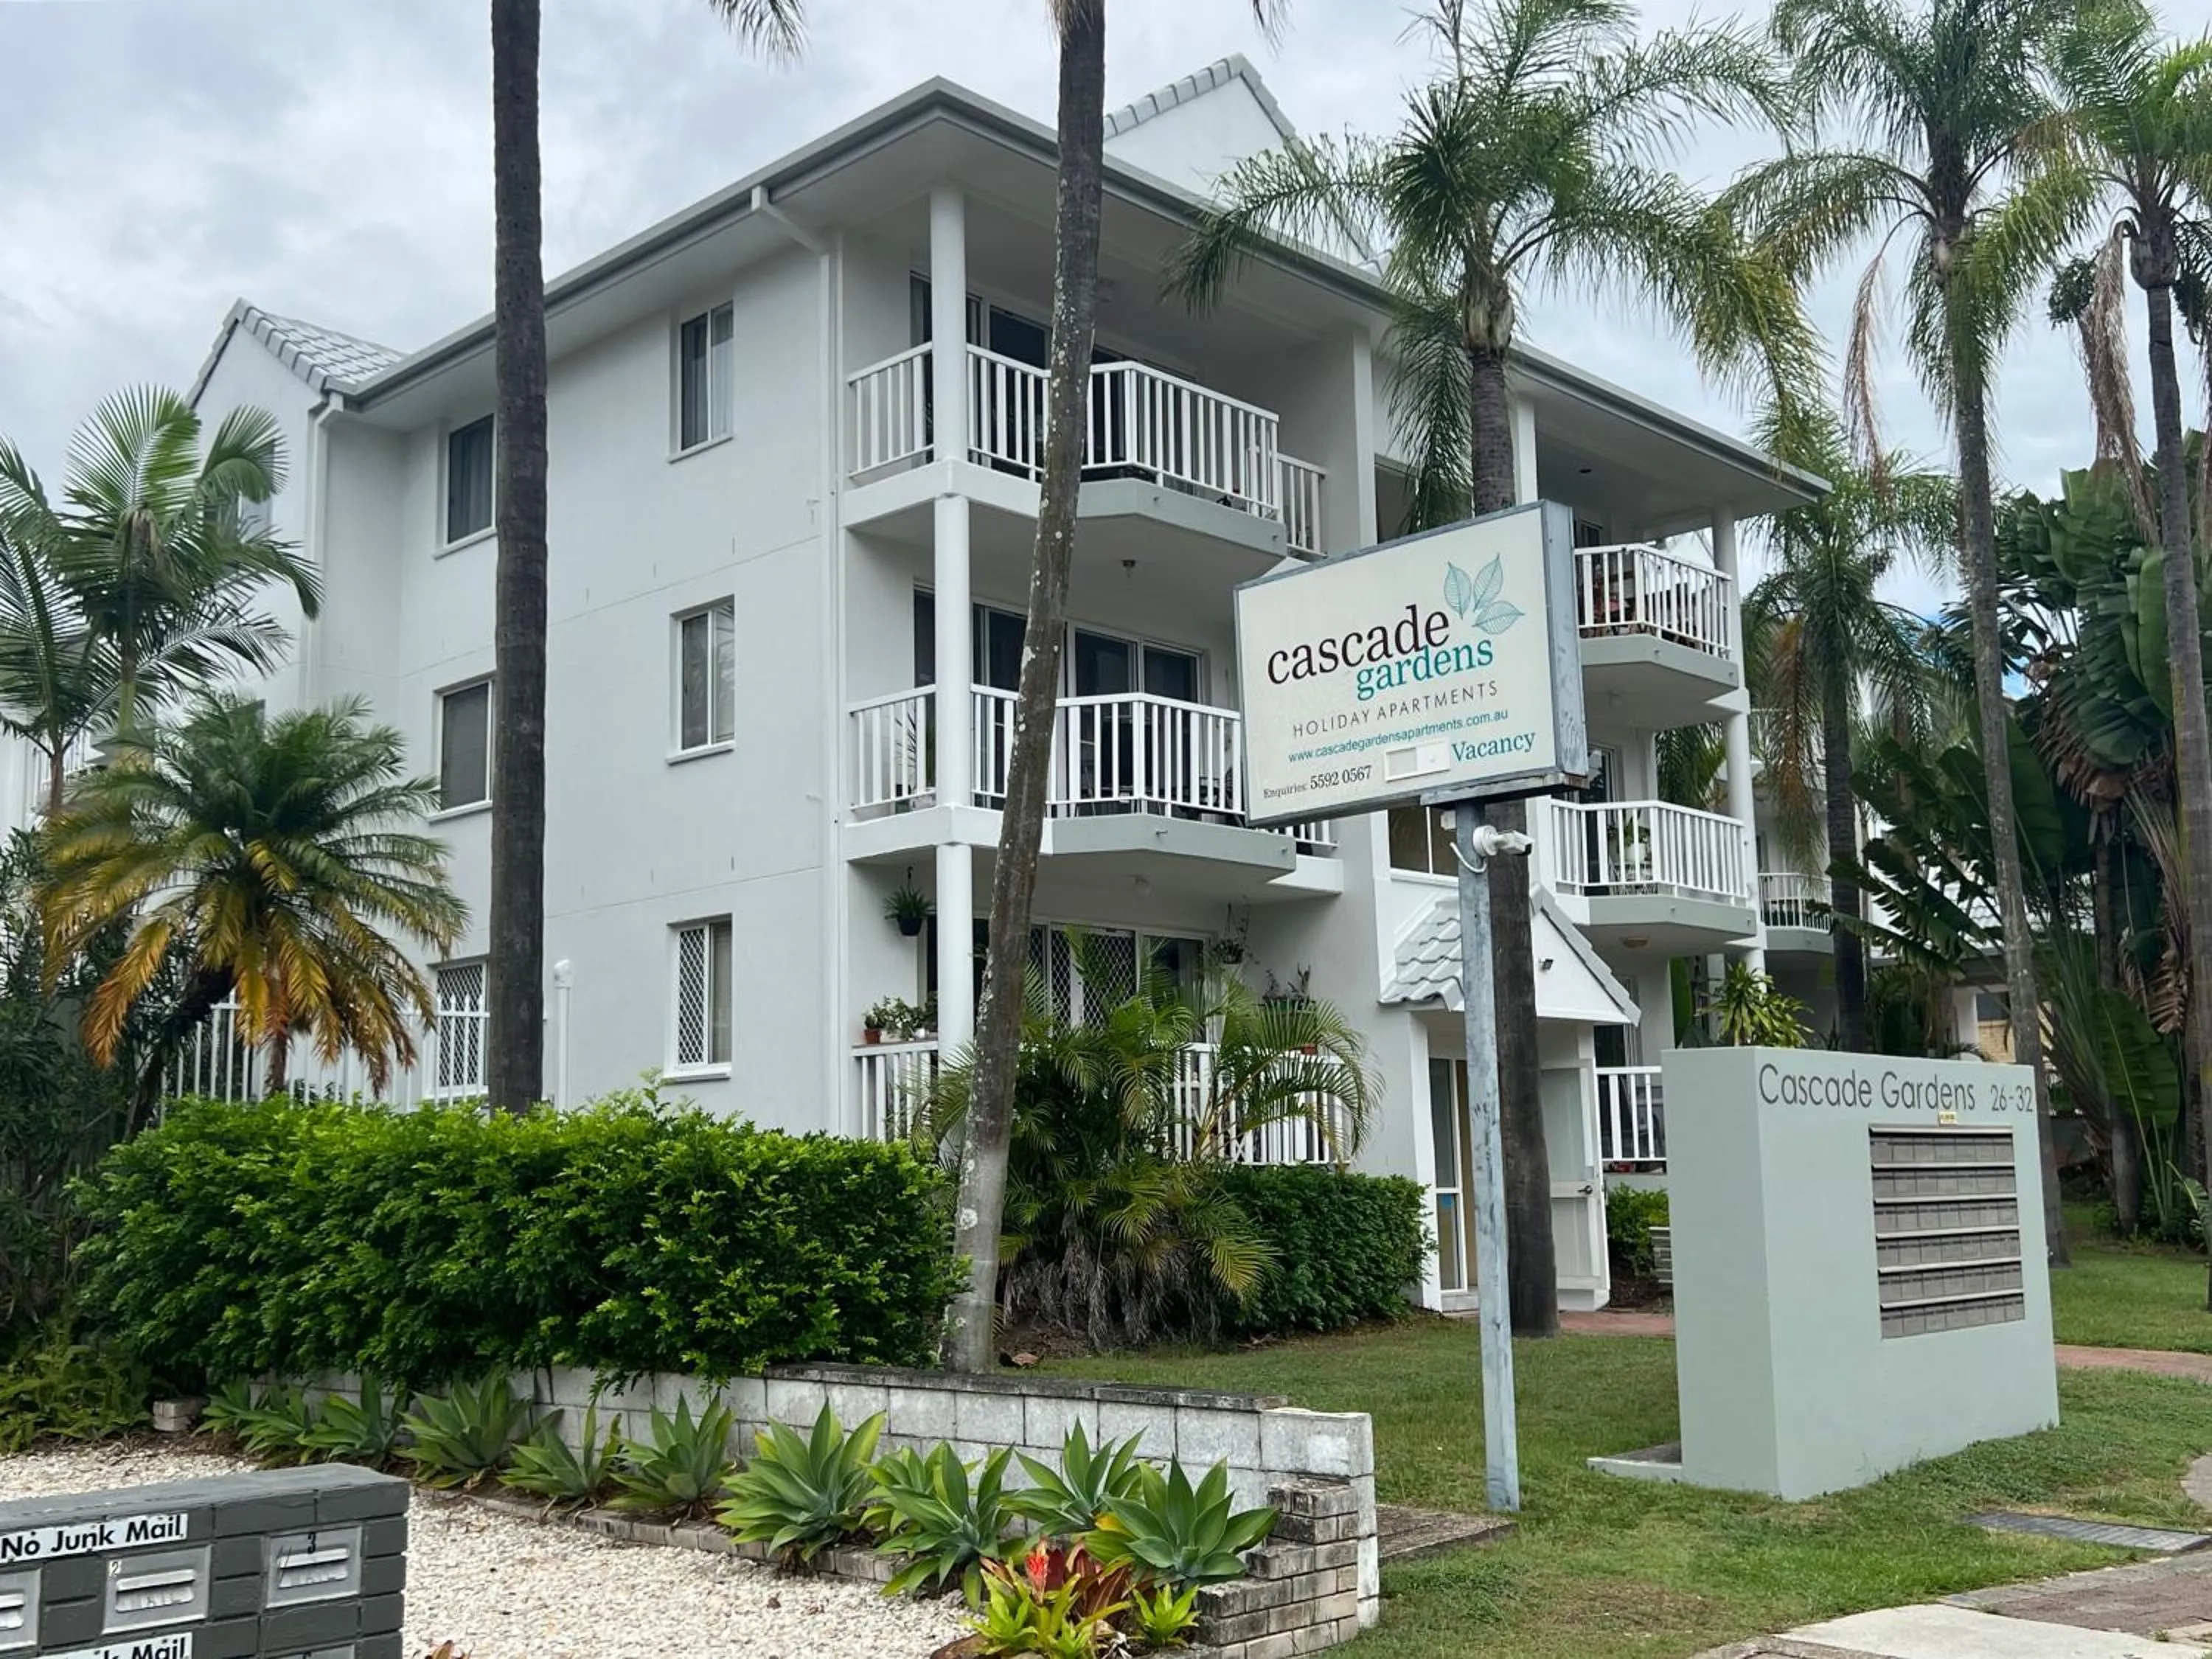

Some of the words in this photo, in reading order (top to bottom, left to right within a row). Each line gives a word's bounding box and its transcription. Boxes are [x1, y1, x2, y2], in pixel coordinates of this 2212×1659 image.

[1267, 605, 1450, 684] cascade
[1356, 639, 1494, 701] gardens
[1293, 709, 1371, 738] HOLIDAY
[1377, 680, 1499, 720] APARTMENTS
[1288, 709, 1509, 763] www.cascadegardensapartments.com.au
[1451, 731, 1537, 762] Vacancy
[1310, 771, 1340, 790] 5592
[1342, 765, 1372, 784] 0567
[1759, 1063, 1872, 1108] Cascade
[1881, 1071, 1976, 1111] Gardens
[1990, 1084, 2034, 1113] 26-32
[1, 1536, 41, 1559] No
[52, 1524, 114, 1552] Junk
[125, 1514, 181, 1543] Mail
[307, 1532, 316, 1554] 3
[111, 1561, 119, 1576] 2
